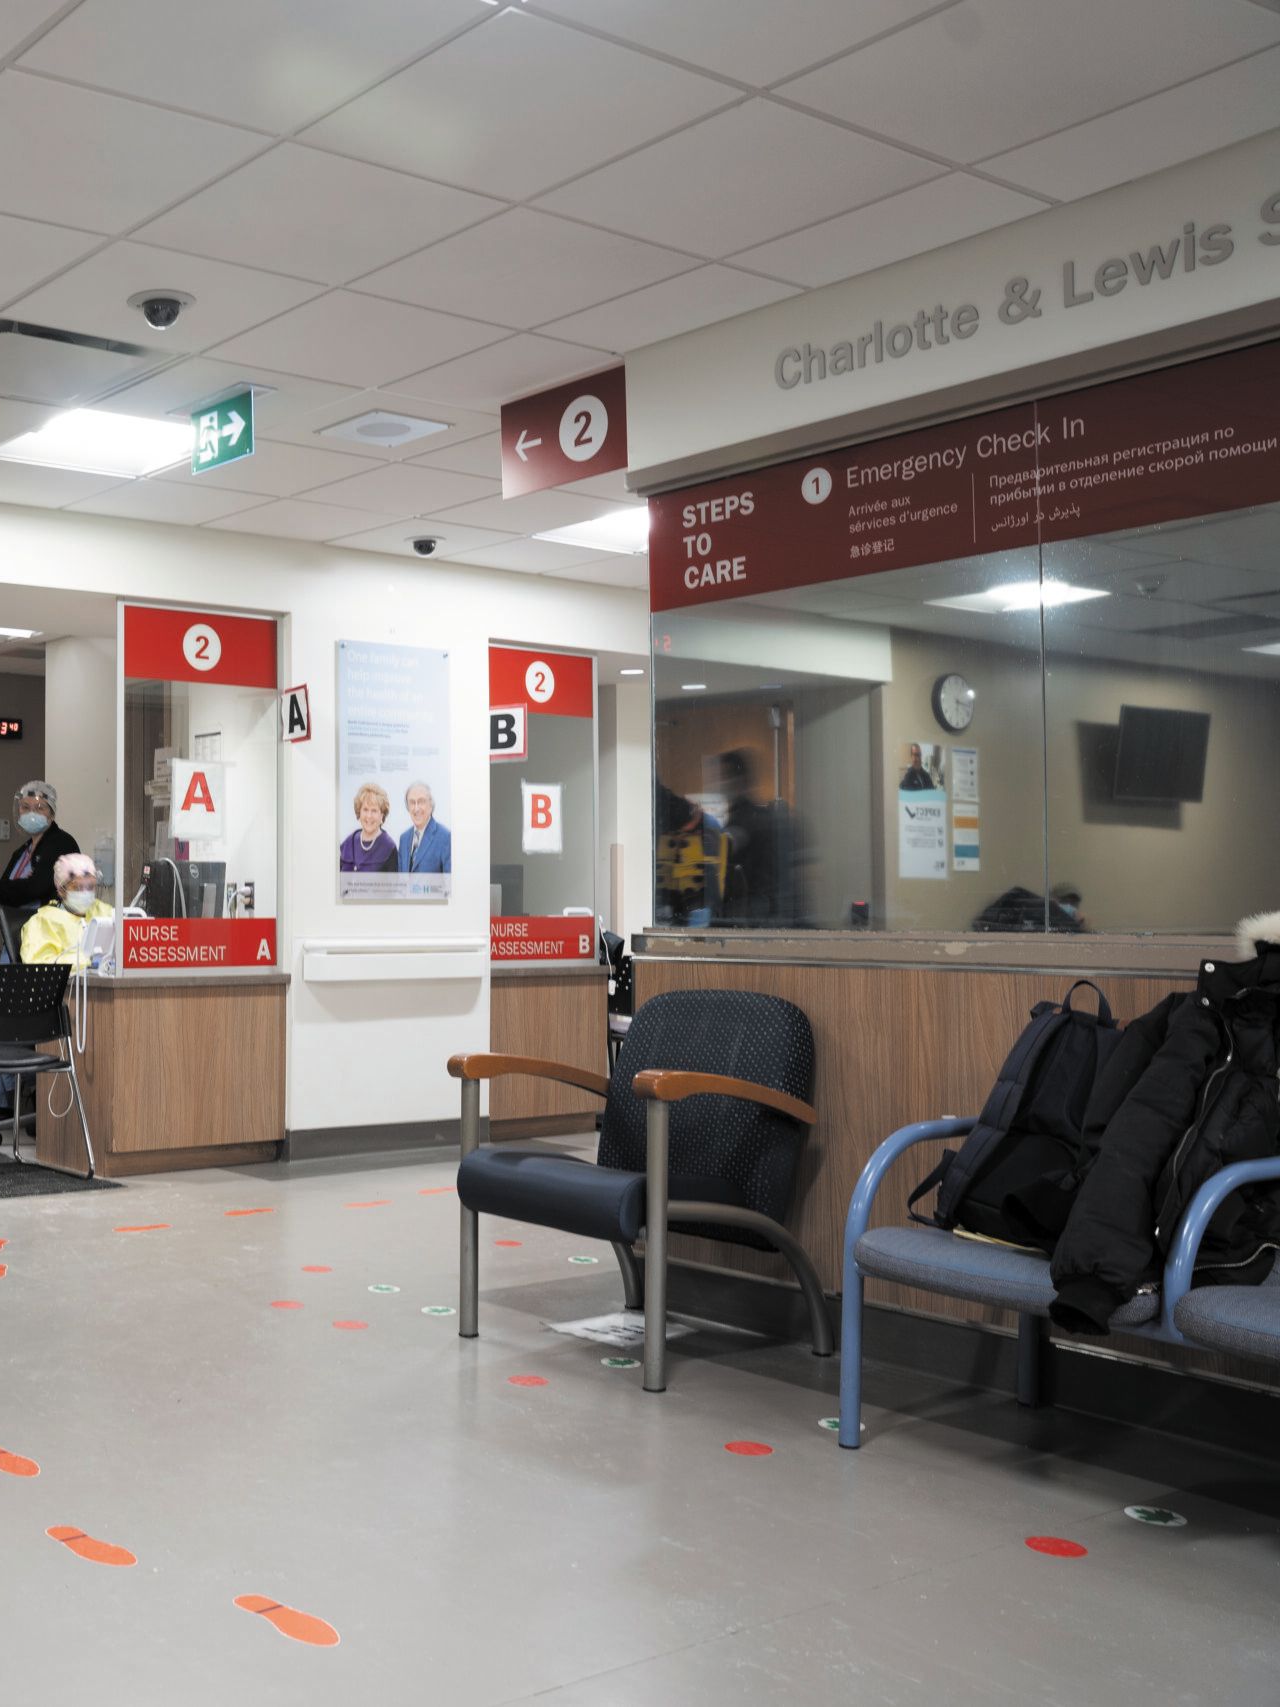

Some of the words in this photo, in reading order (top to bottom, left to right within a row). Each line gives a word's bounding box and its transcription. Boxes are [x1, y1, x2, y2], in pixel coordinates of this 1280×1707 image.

[774, 303, 980, 390] Charlotte
[998, 277, 1042, 326] &
[1062, 221, 1235, 309] Lewis
[574, 410, 593, 447] 2
[846, 446, 967, 488] Emergency
[976, 423, 1051, 458] Check
[1062, 417, 1085, 440] In
[989, 453, 1109, 489] Предварительная
[1113, 432, 1210, 466] регистрация
[1214, 427, 1235, 441] по
[989, 482, 1055, 507] прибытии
[1058, 480, 1066, 492] в
[1070, 464, 1145, 490] отделение
[1148, 450, 1205, 475] скорой
[1208, 437, 1278, 462] помощи
[811, 476, 821, 496] 1
[682, 491, 755, 528] STEPS
[848, 500, 888, 517] Arrivée
[891, 496, 911, 508] aux
[899, 503, 958, 523] d'urgence
[682, 532, 713, 559] TO
[850, 538, 895, 559] 急诊登记
[684, 556, 747, 590] CARE
[195, 635, 210, 660] 2
[534, 672, 546, 693] 2
[289, 693, 306, 734] A
[490, 713, 517, 750] B
[181, 771, 215, 812] A
[531, 793, 553, 829] B
[128, 925, 179, 942] NURSE
[491, 923, 528, 937] NURSE
[128, 946, 227, 962] ASSESSMENT
[256, 938, 271, 961] A
[491, 941, 564, 955] ASSESSMENT
[579, 934, 590, 954] B
